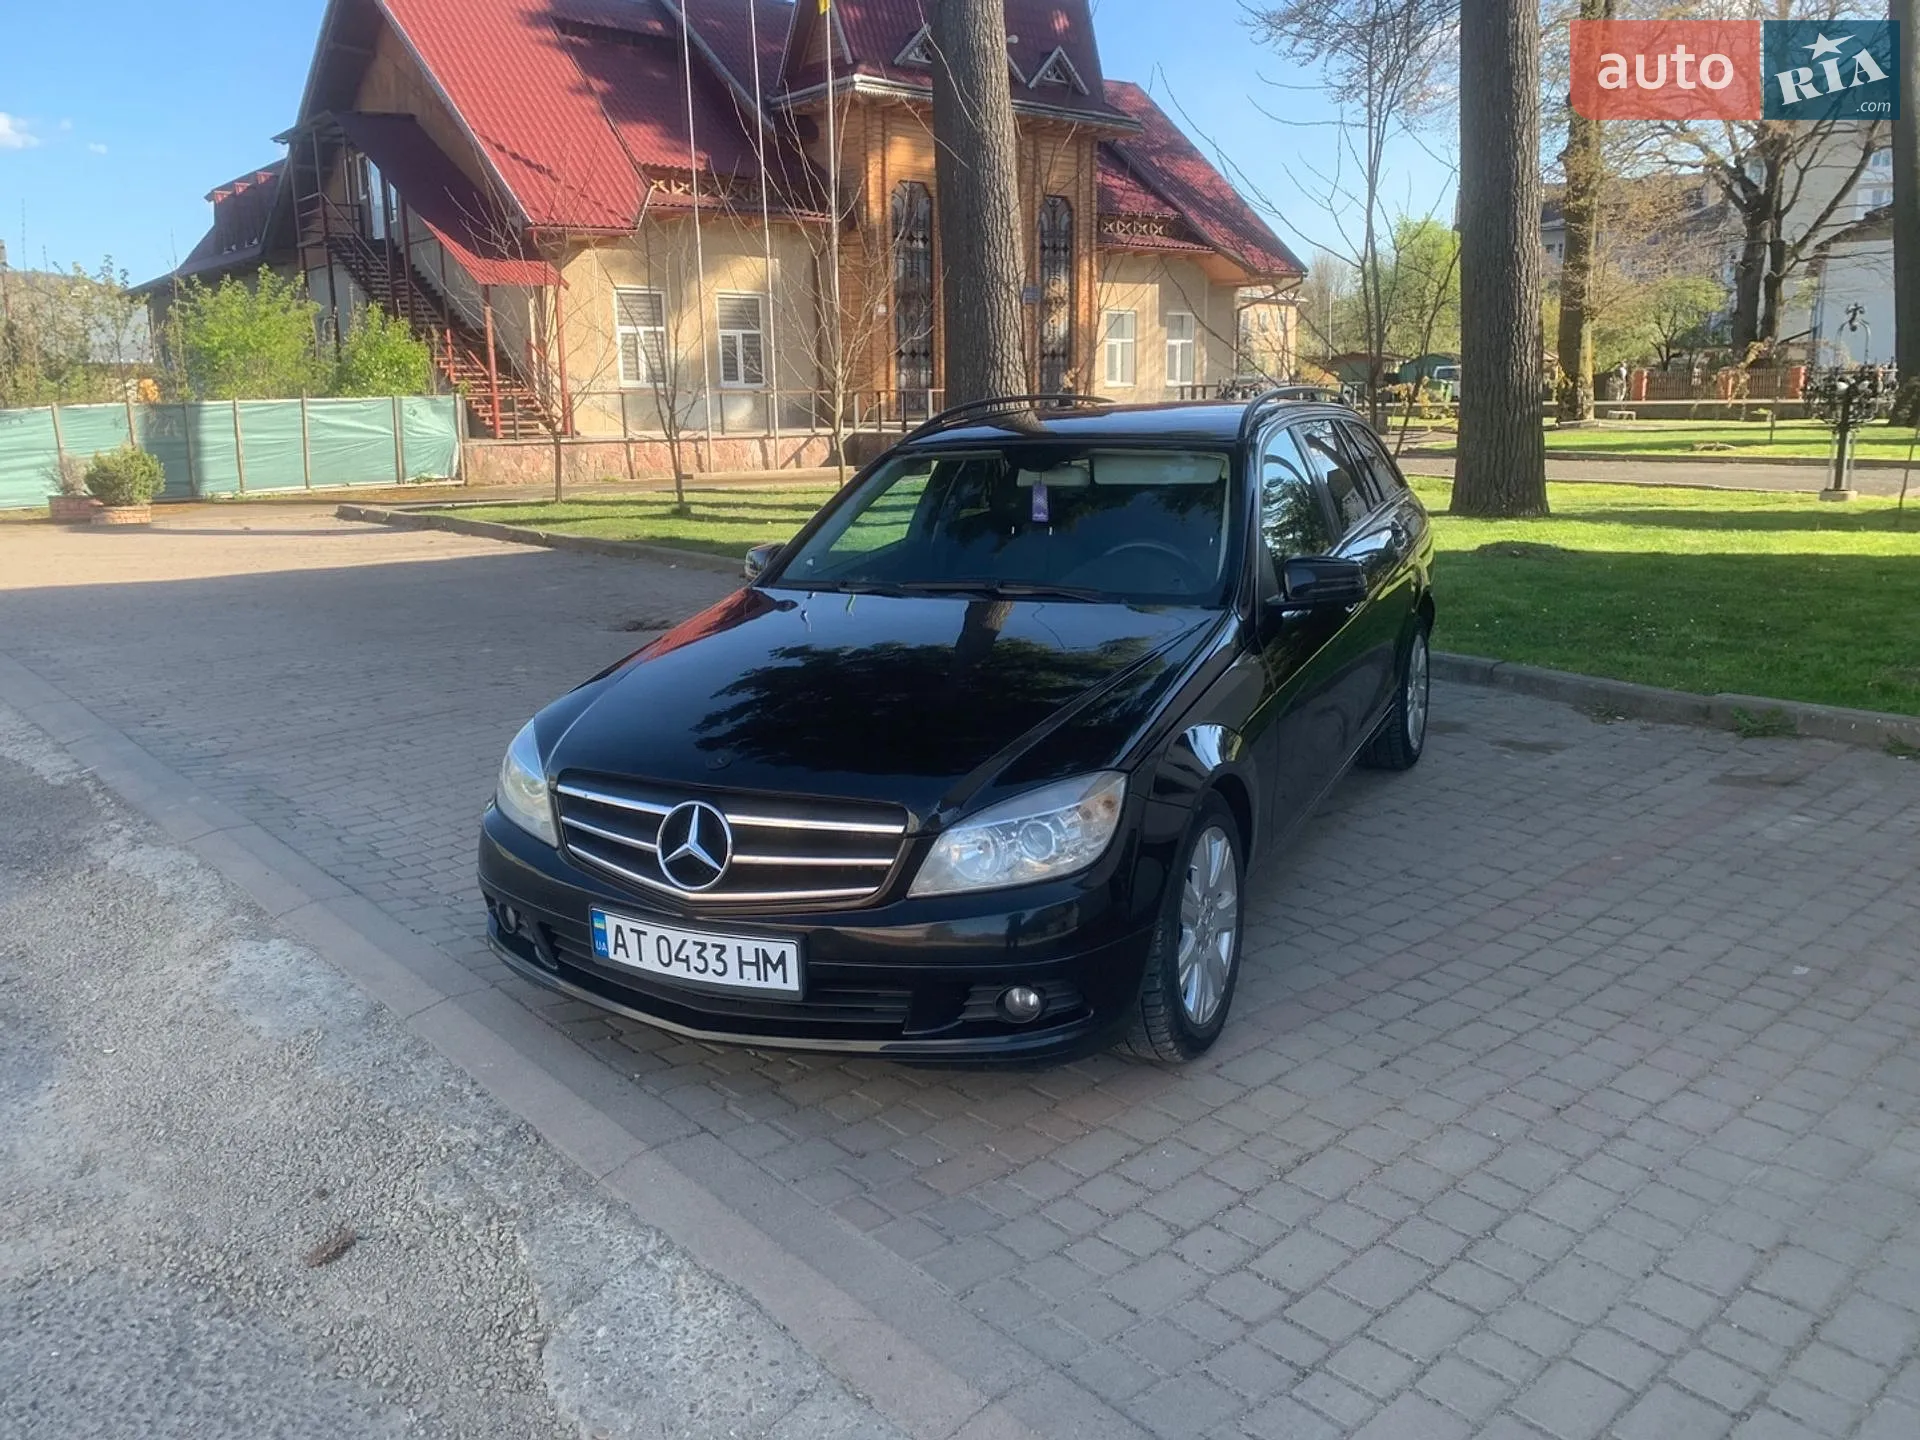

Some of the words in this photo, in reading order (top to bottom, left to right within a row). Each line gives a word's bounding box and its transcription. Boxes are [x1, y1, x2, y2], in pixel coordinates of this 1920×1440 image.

[613, 924, 647, 962] AT
[656, 935, 728, 977] 0433
[737, 946, 788, 984] HM
